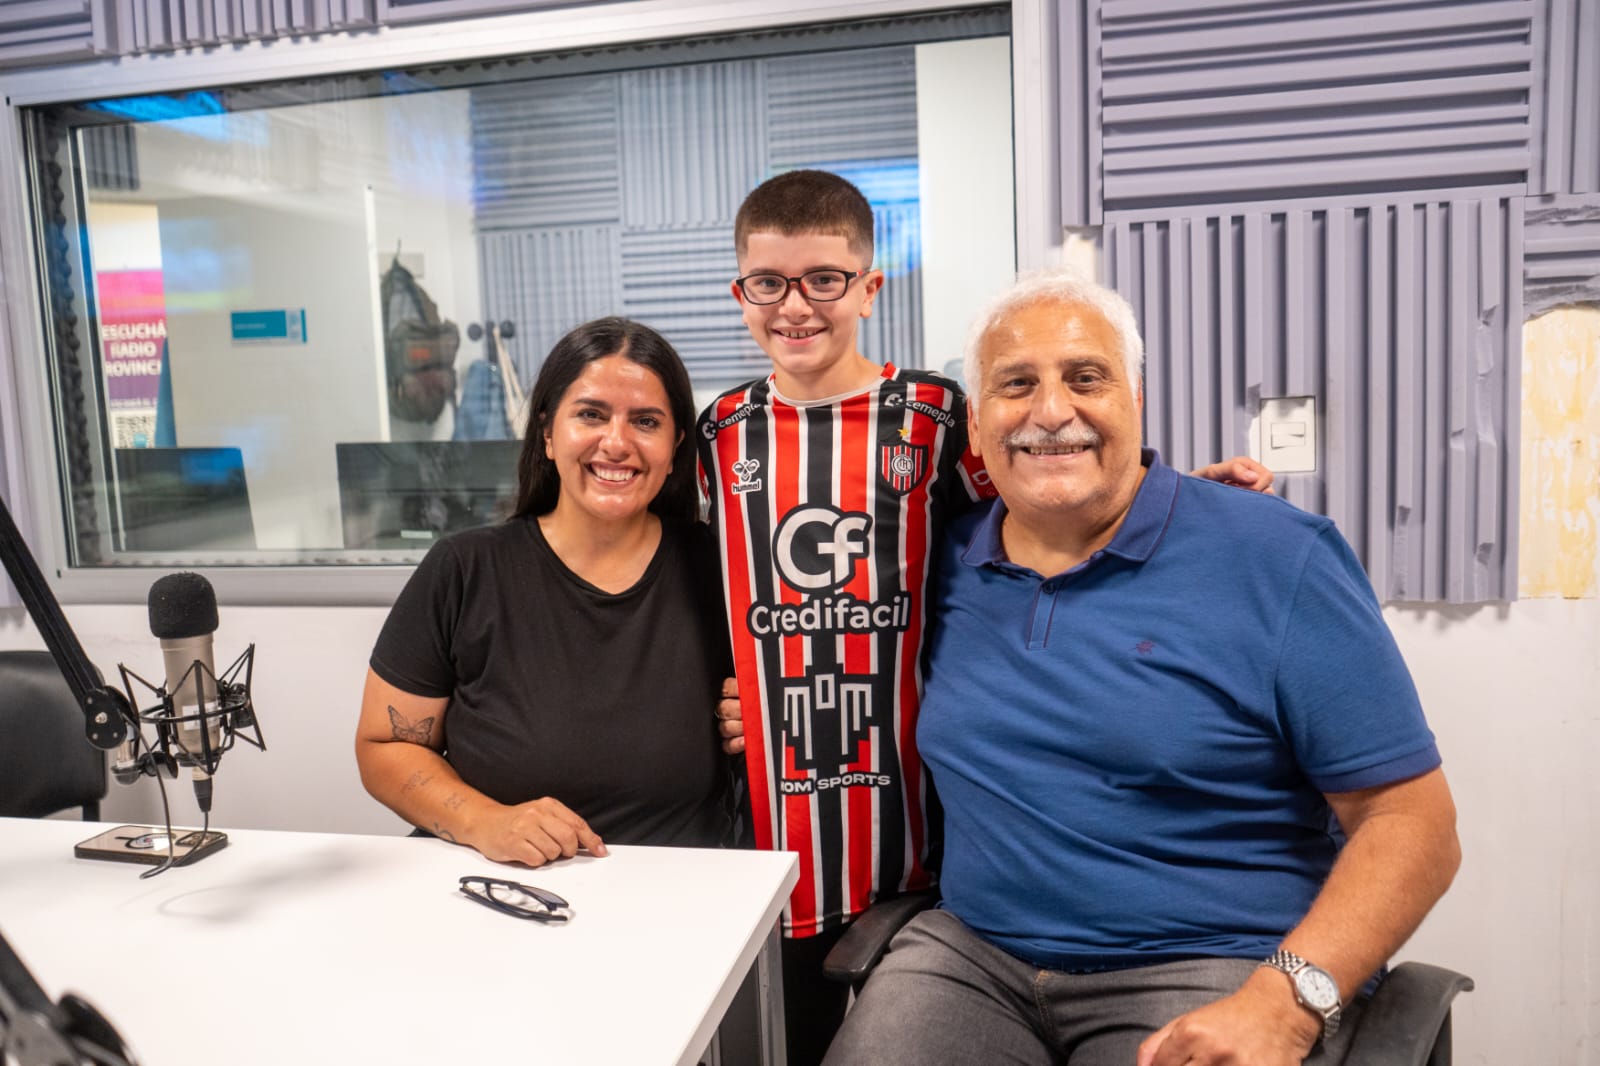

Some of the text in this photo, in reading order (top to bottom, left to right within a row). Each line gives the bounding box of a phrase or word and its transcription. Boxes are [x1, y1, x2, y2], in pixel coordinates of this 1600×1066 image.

[104, 359, 161, 377] ROVINCI
[905, 399, 956, 428] cemepla
[732, 480, 761, 493] hummel
[750, 595, 910, 635] Credifacil
[817, 773, 891, 790] SPORTS
